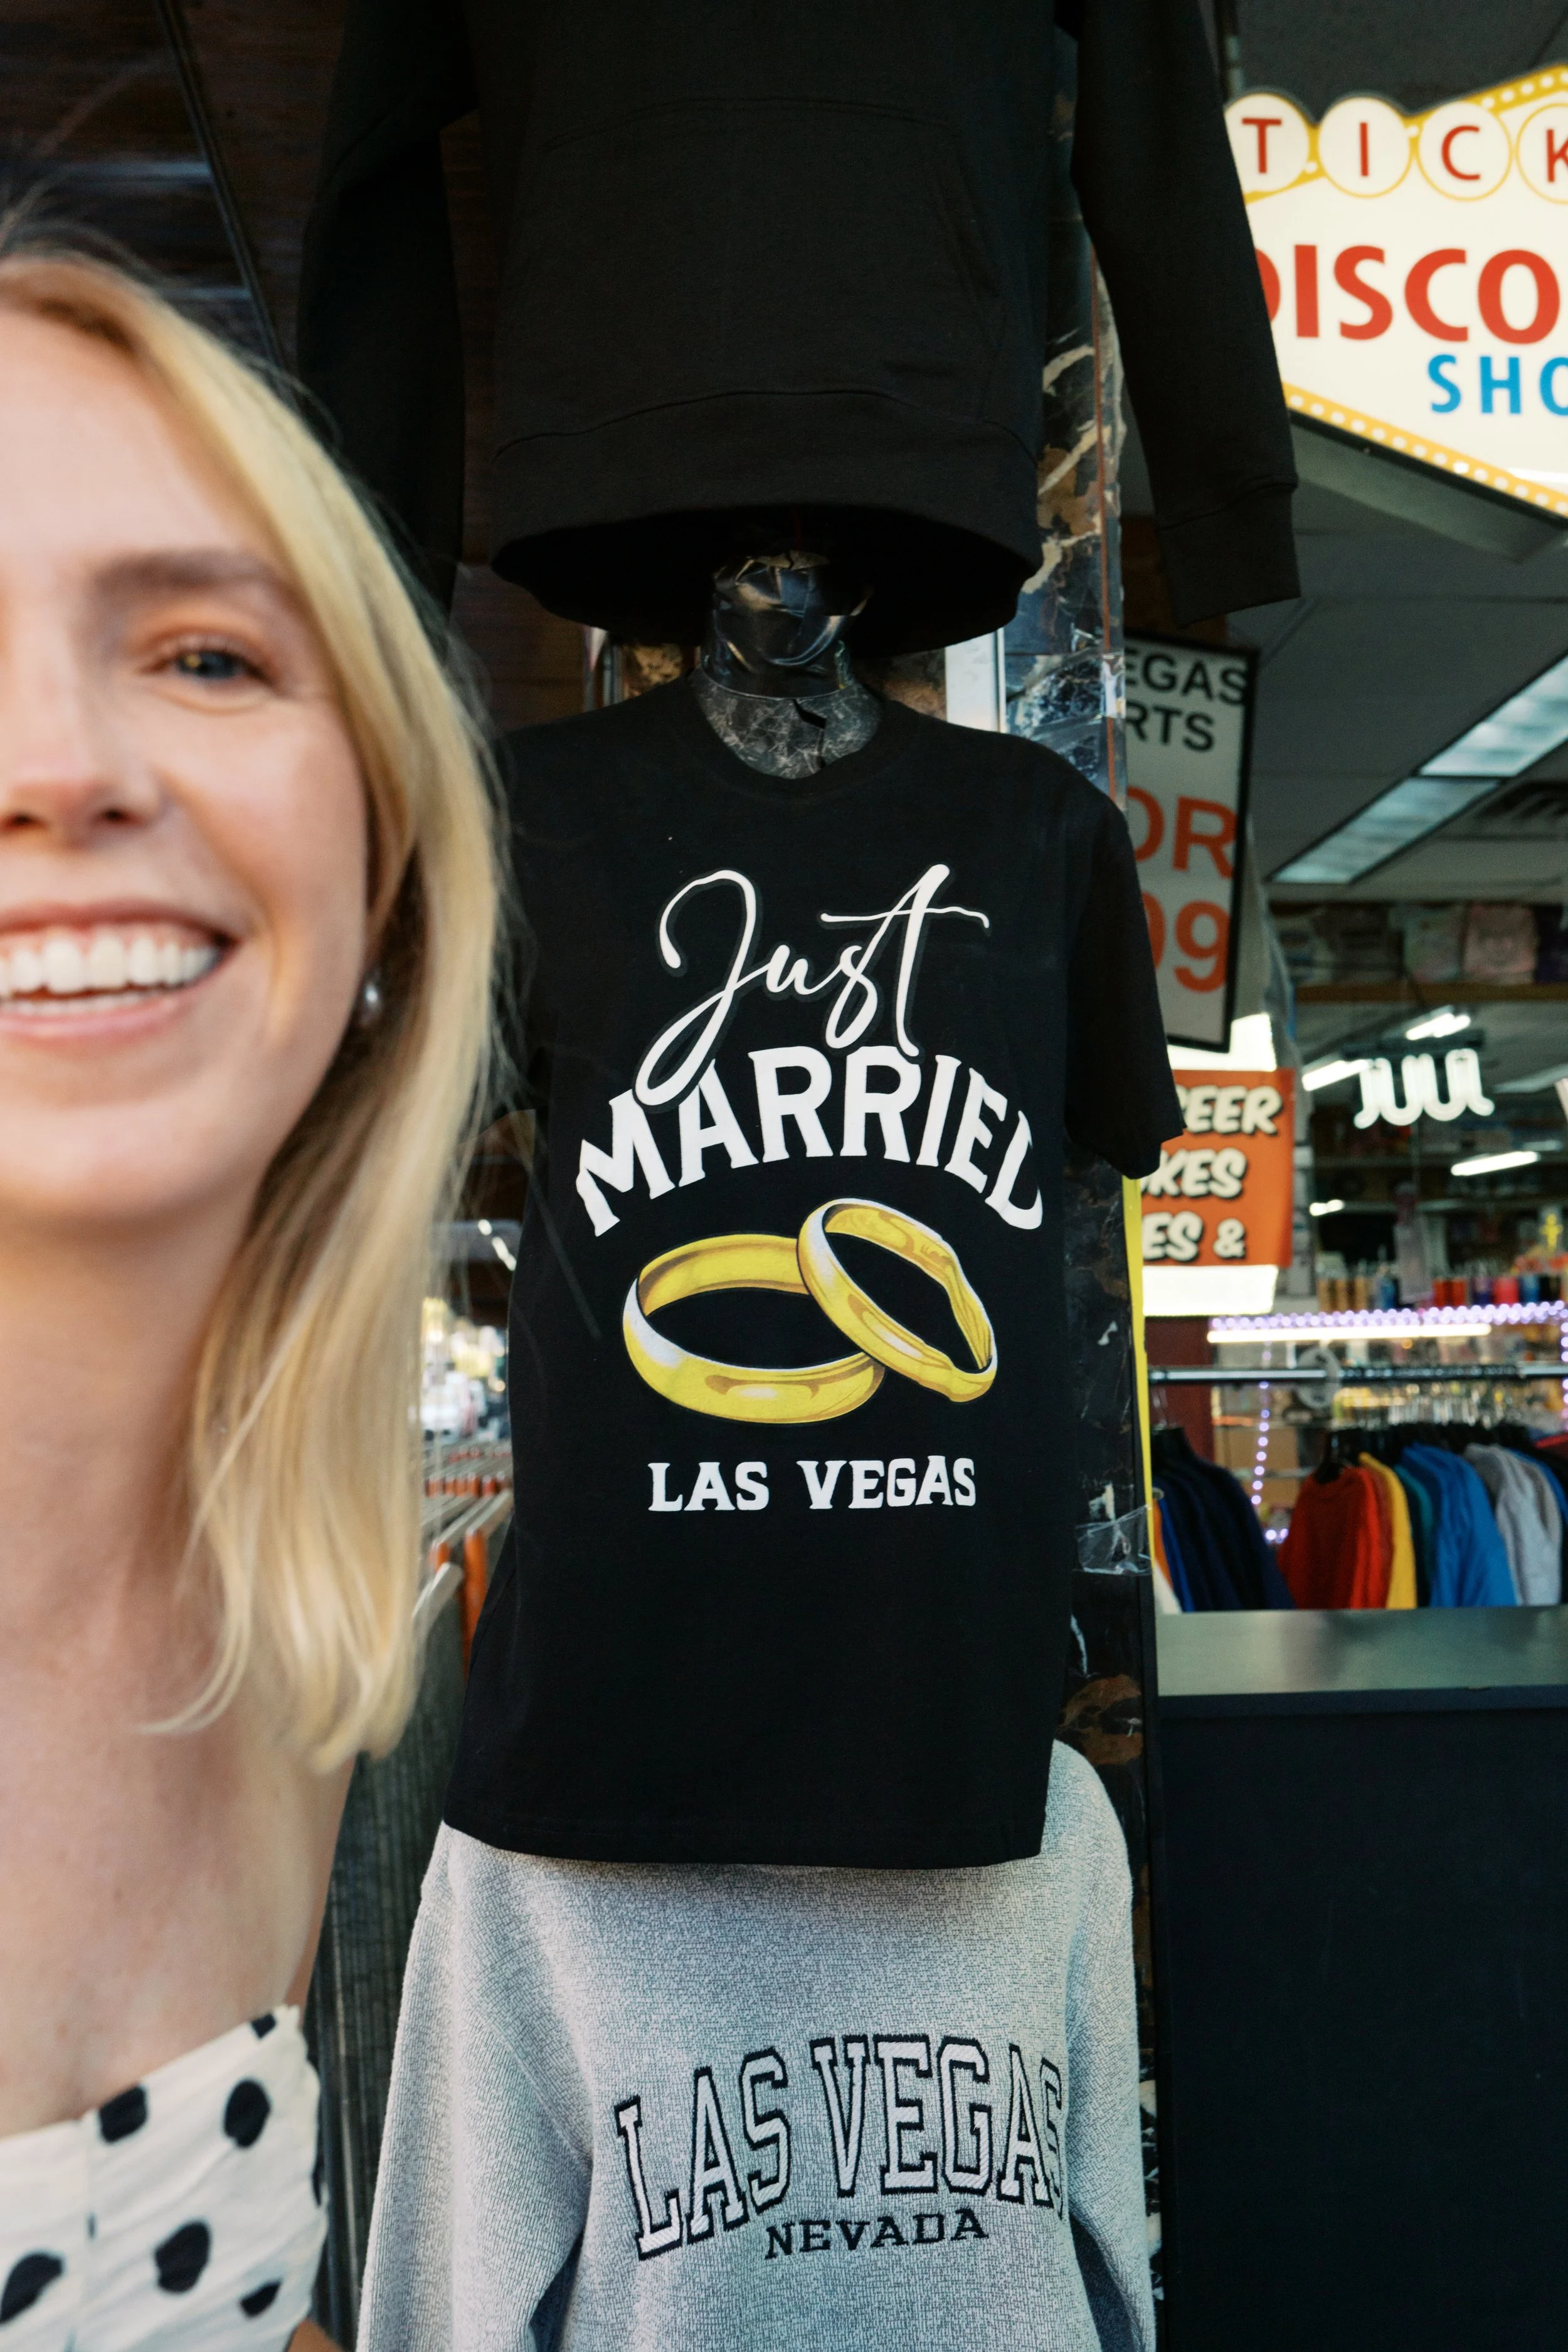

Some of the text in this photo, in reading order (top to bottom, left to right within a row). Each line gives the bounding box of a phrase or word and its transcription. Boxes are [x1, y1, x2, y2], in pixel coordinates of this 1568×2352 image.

[635, 864, 990, 1106] Just
[1140, 1147, 1248, 1199] KES
[1212, 1217, 1246, 1259] &
[647, 1454, 977, 1512] LAS VEGAS
[614, 2033, 1064, 2259] LAS VEGAS
[765, 2207, 989, 2259] NEVADA
